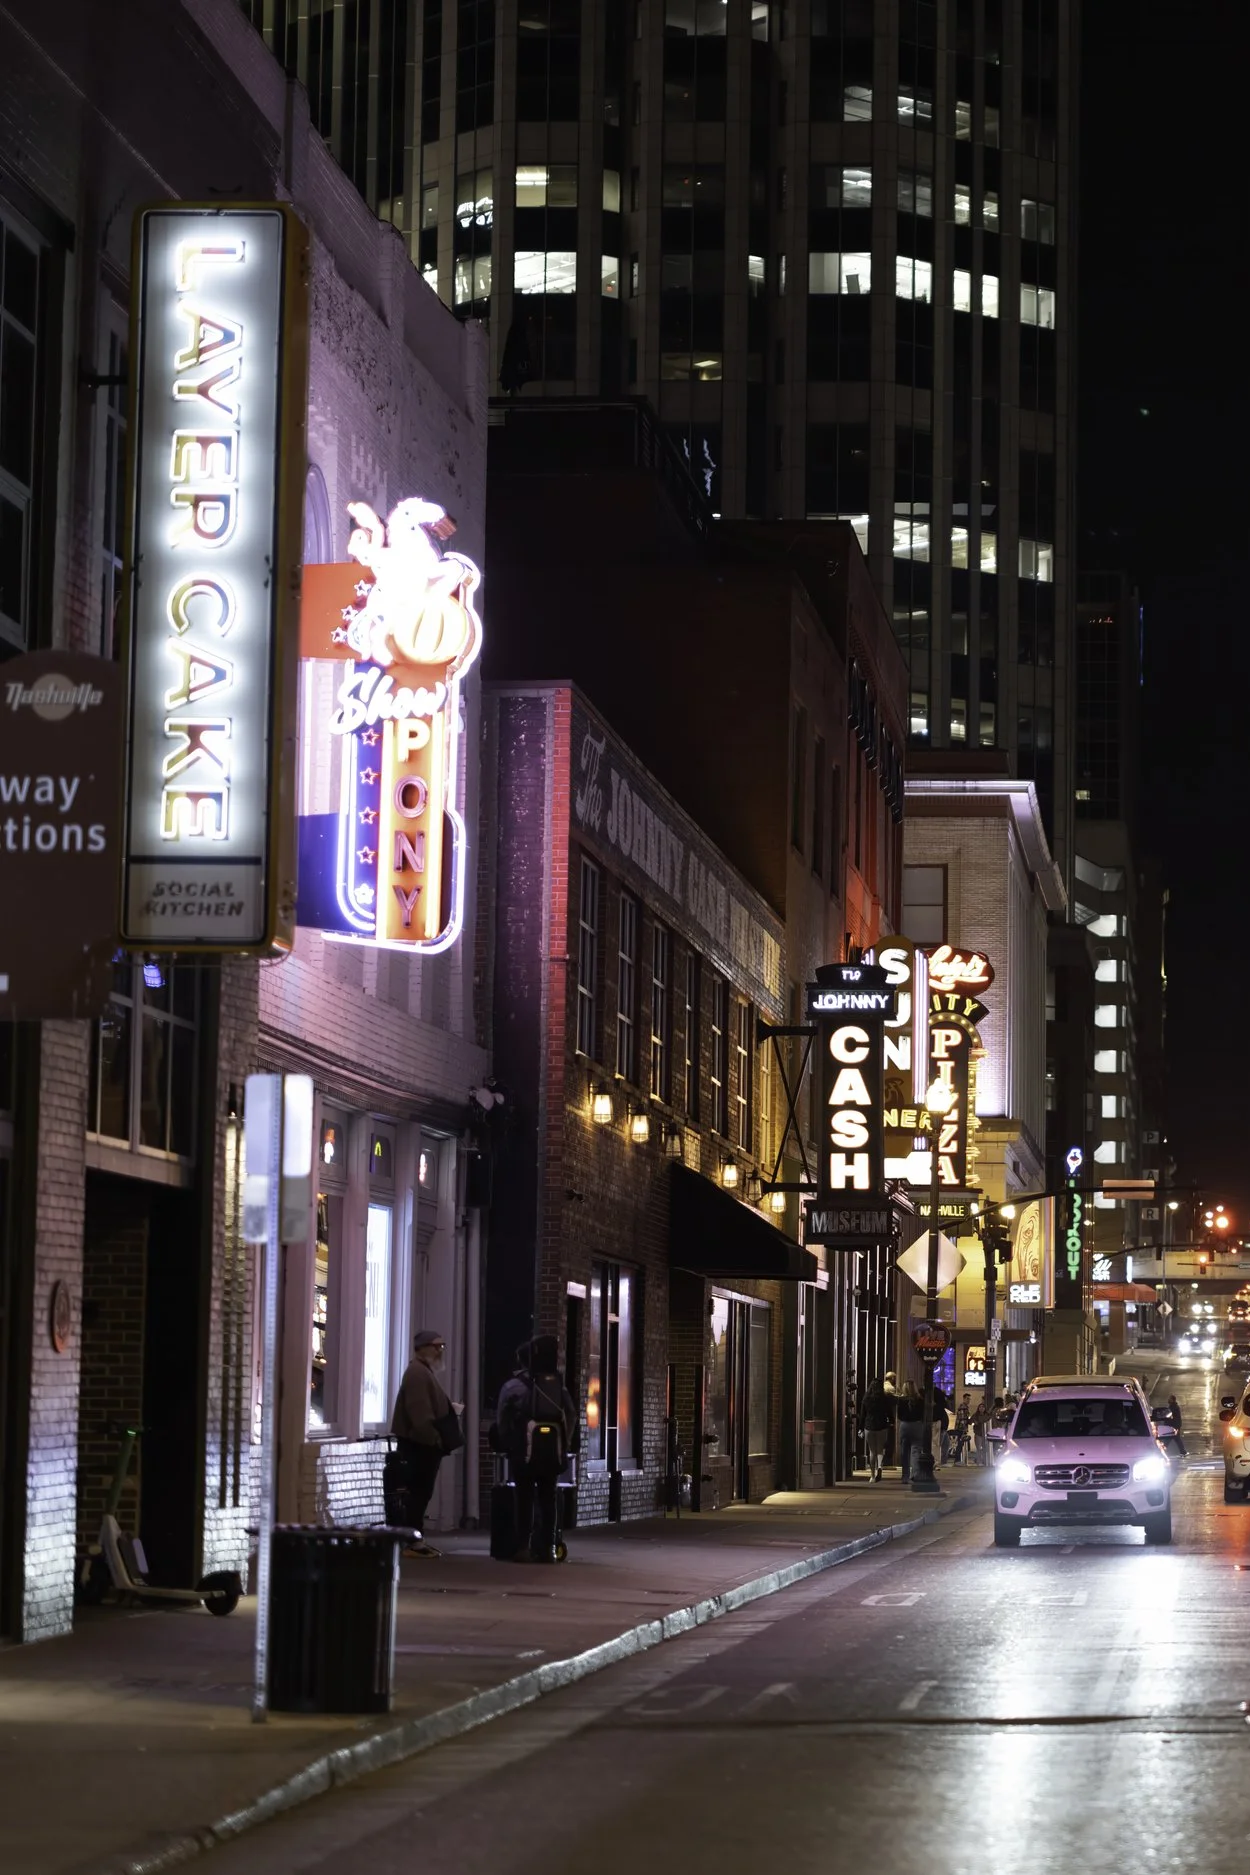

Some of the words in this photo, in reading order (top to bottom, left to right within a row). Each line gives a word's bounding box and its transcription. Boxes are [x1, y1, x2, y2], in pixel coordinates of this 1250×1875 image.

[169, 238, 246, 549] LAYER
[5, 681, 104, 712] Nashville
[160, 570, 237, 841] CAKE
[328, 658, 447, 735] Show
[0, 775, 80, 811] way
[0, 815, 106, 850] tions
[392, 716, 431, 928] PONY
[575, 722, 606, 832] The
[607, 767, 684, 906] JOHNNY
[688, 850, 727, 948] CASH
[153, 880, 235, 898] SOCIAL
[145, 900, 244, 917] KITCHEN
[813, 994, 889, 1009] JOHNNY
[929, 994, 979, 1017] ITY
[829, 1025, 872, 1190] CASH
[884, 1109, 932, 1130] NER
[811, 1210, 888, 1234] MUSEUM
[920, 1204, 965, 1217] NAHVILLE
